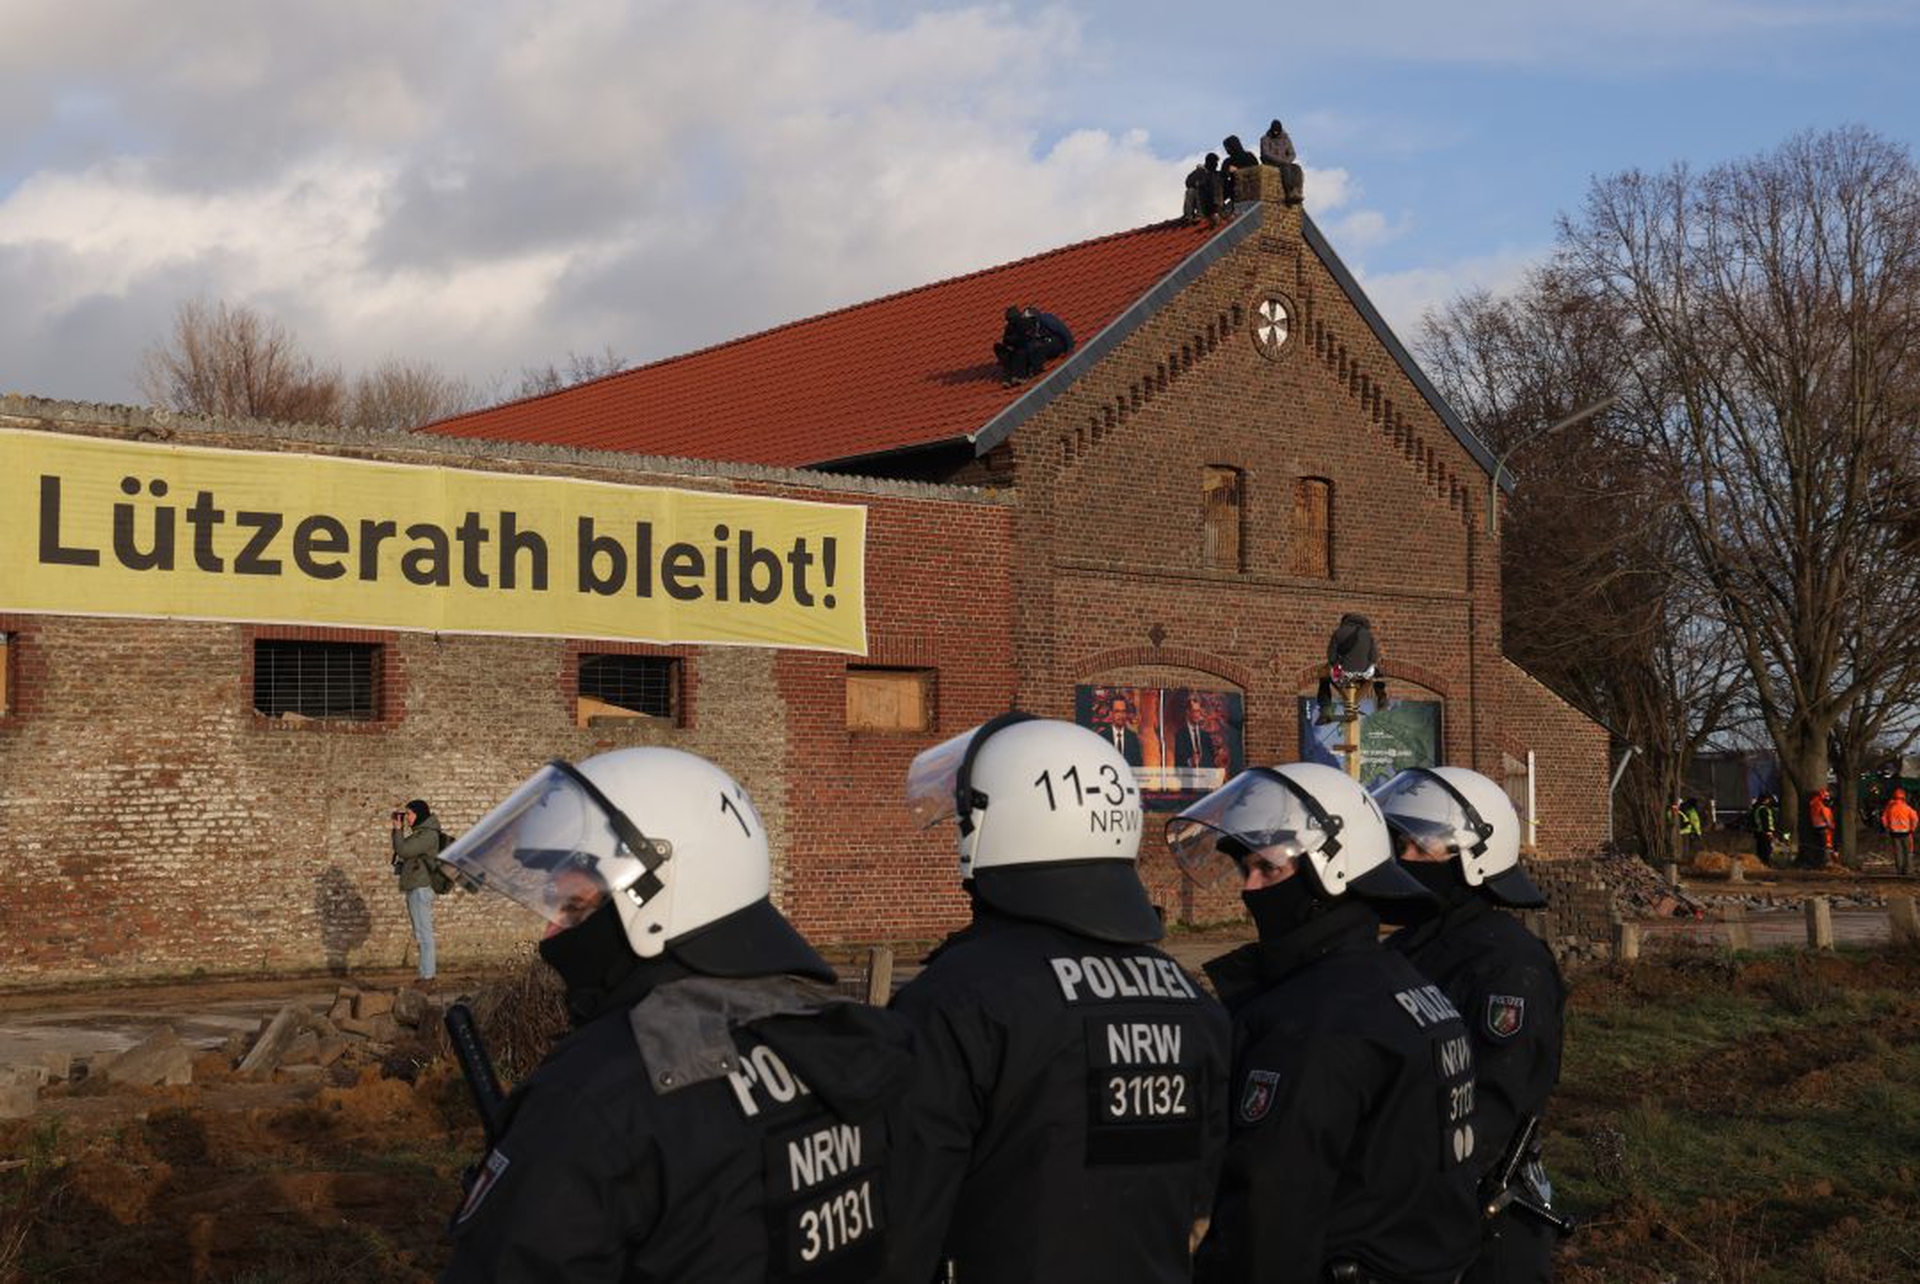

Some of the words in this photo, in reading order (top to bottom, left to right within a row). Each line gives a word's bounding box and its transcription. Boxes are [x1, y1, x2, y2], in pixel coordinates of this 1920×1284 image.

[38, 475, 549, 591] Lützerath
[577, 515, 837, 609] bleibt!
[1090, 810, 1139, 833] NRW
[1050, 956, 1198, 1001] POLIZEI
[1106, 1022, 1182, 1065] NRW
[1108, 1074, 1187, 1117] 31132
[788, 1124, 861, 1192] NRW
[800, 1180, 874, 1262] 31131
